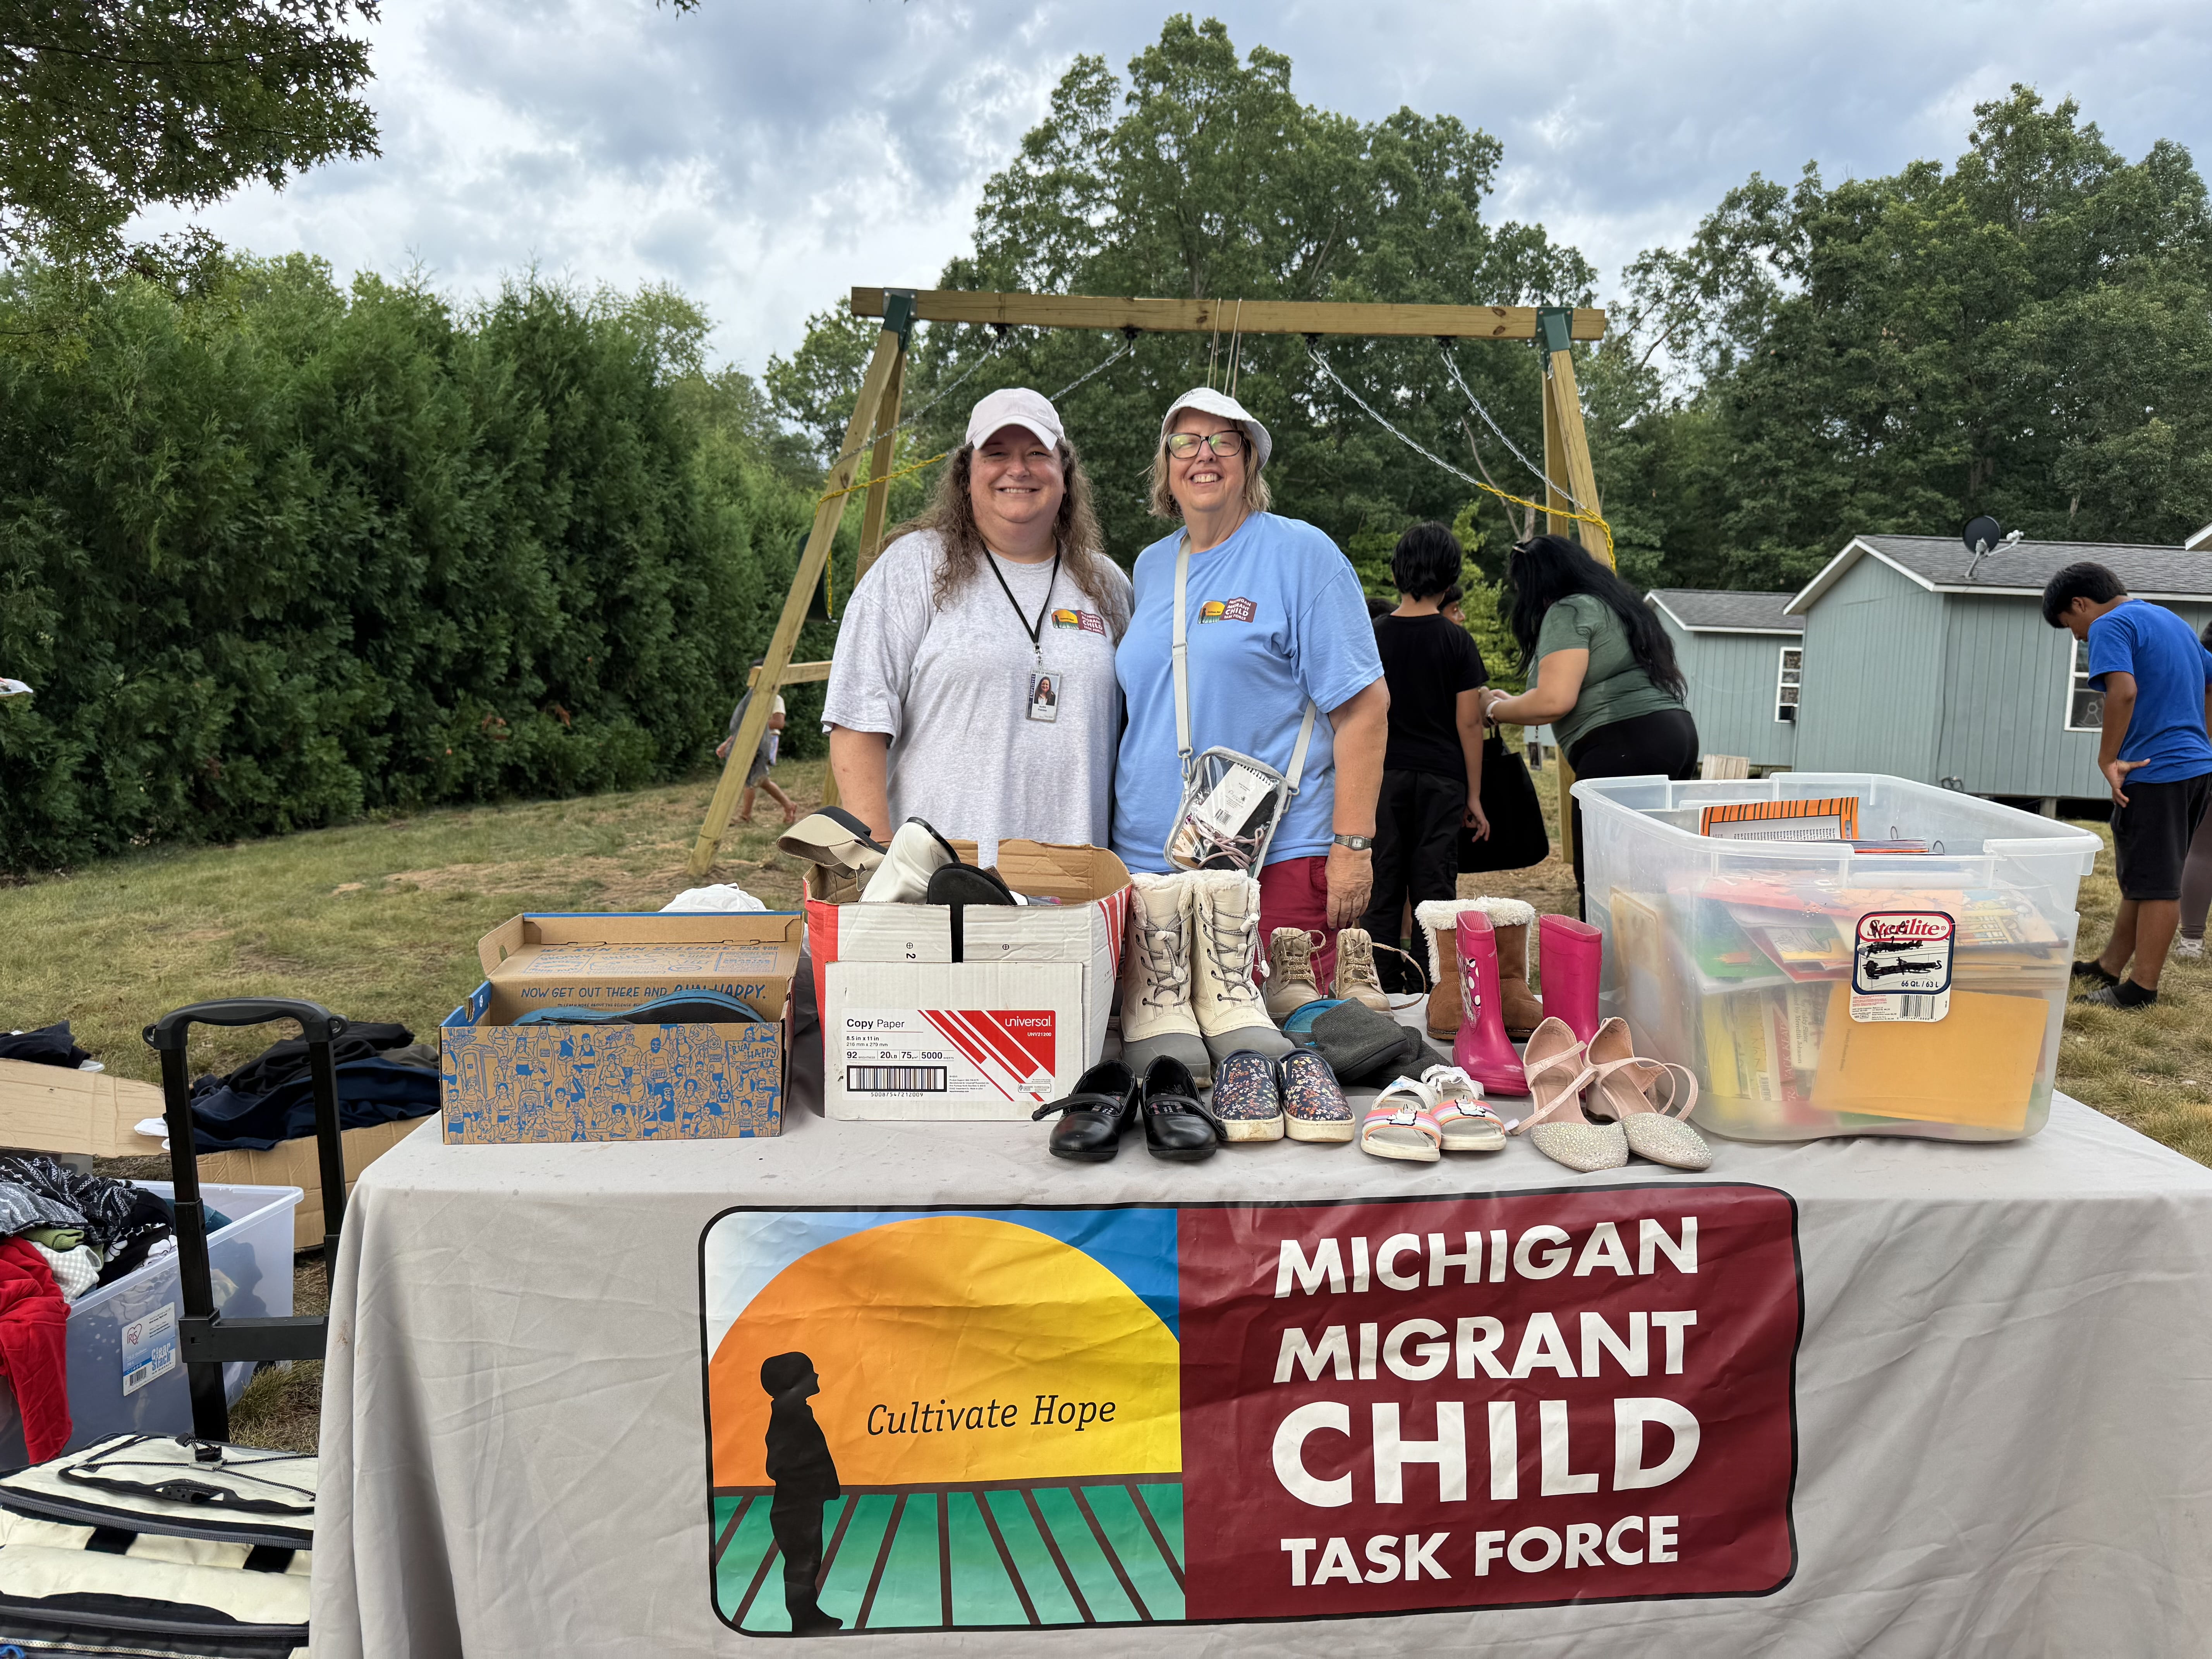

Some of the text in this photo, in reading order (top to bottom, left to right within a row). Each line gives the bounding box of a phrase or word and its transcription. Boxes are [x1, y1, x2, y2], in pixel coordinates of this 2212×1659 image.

[1229, 598, 1251, 606] MICHIGAN
[1225, 607, 1249, 617] CHILD
[1082, 620, 1103, 630] CHILD
[521, 988, 550, 998] NOW
[552, 988, 575, 998] GET
[579, 988, 602, 997] OUT
[606, 987, 640, 997] THERE
[644, 987, 667, 997] AND
[847, 1018, 905, 1030] Copy Paper
[732, 1043, 750, 1055] RUN
[747, 1048, 776, 1059] HAPPY
[1274, 1217, 1698, 1298] MICHIGAN
[152, 1343, 170, 1360] Clear
[1273, 1310, 1697, 1383] MIGRANT
[152, 1352, 170, 1371] Stack
[867, 1395, 1116, 1436] Cultivate Hope
[1273, 1397, 1701, 1508] CHILD
[1281, 1515, 1678, 1587] TASK FORCE
